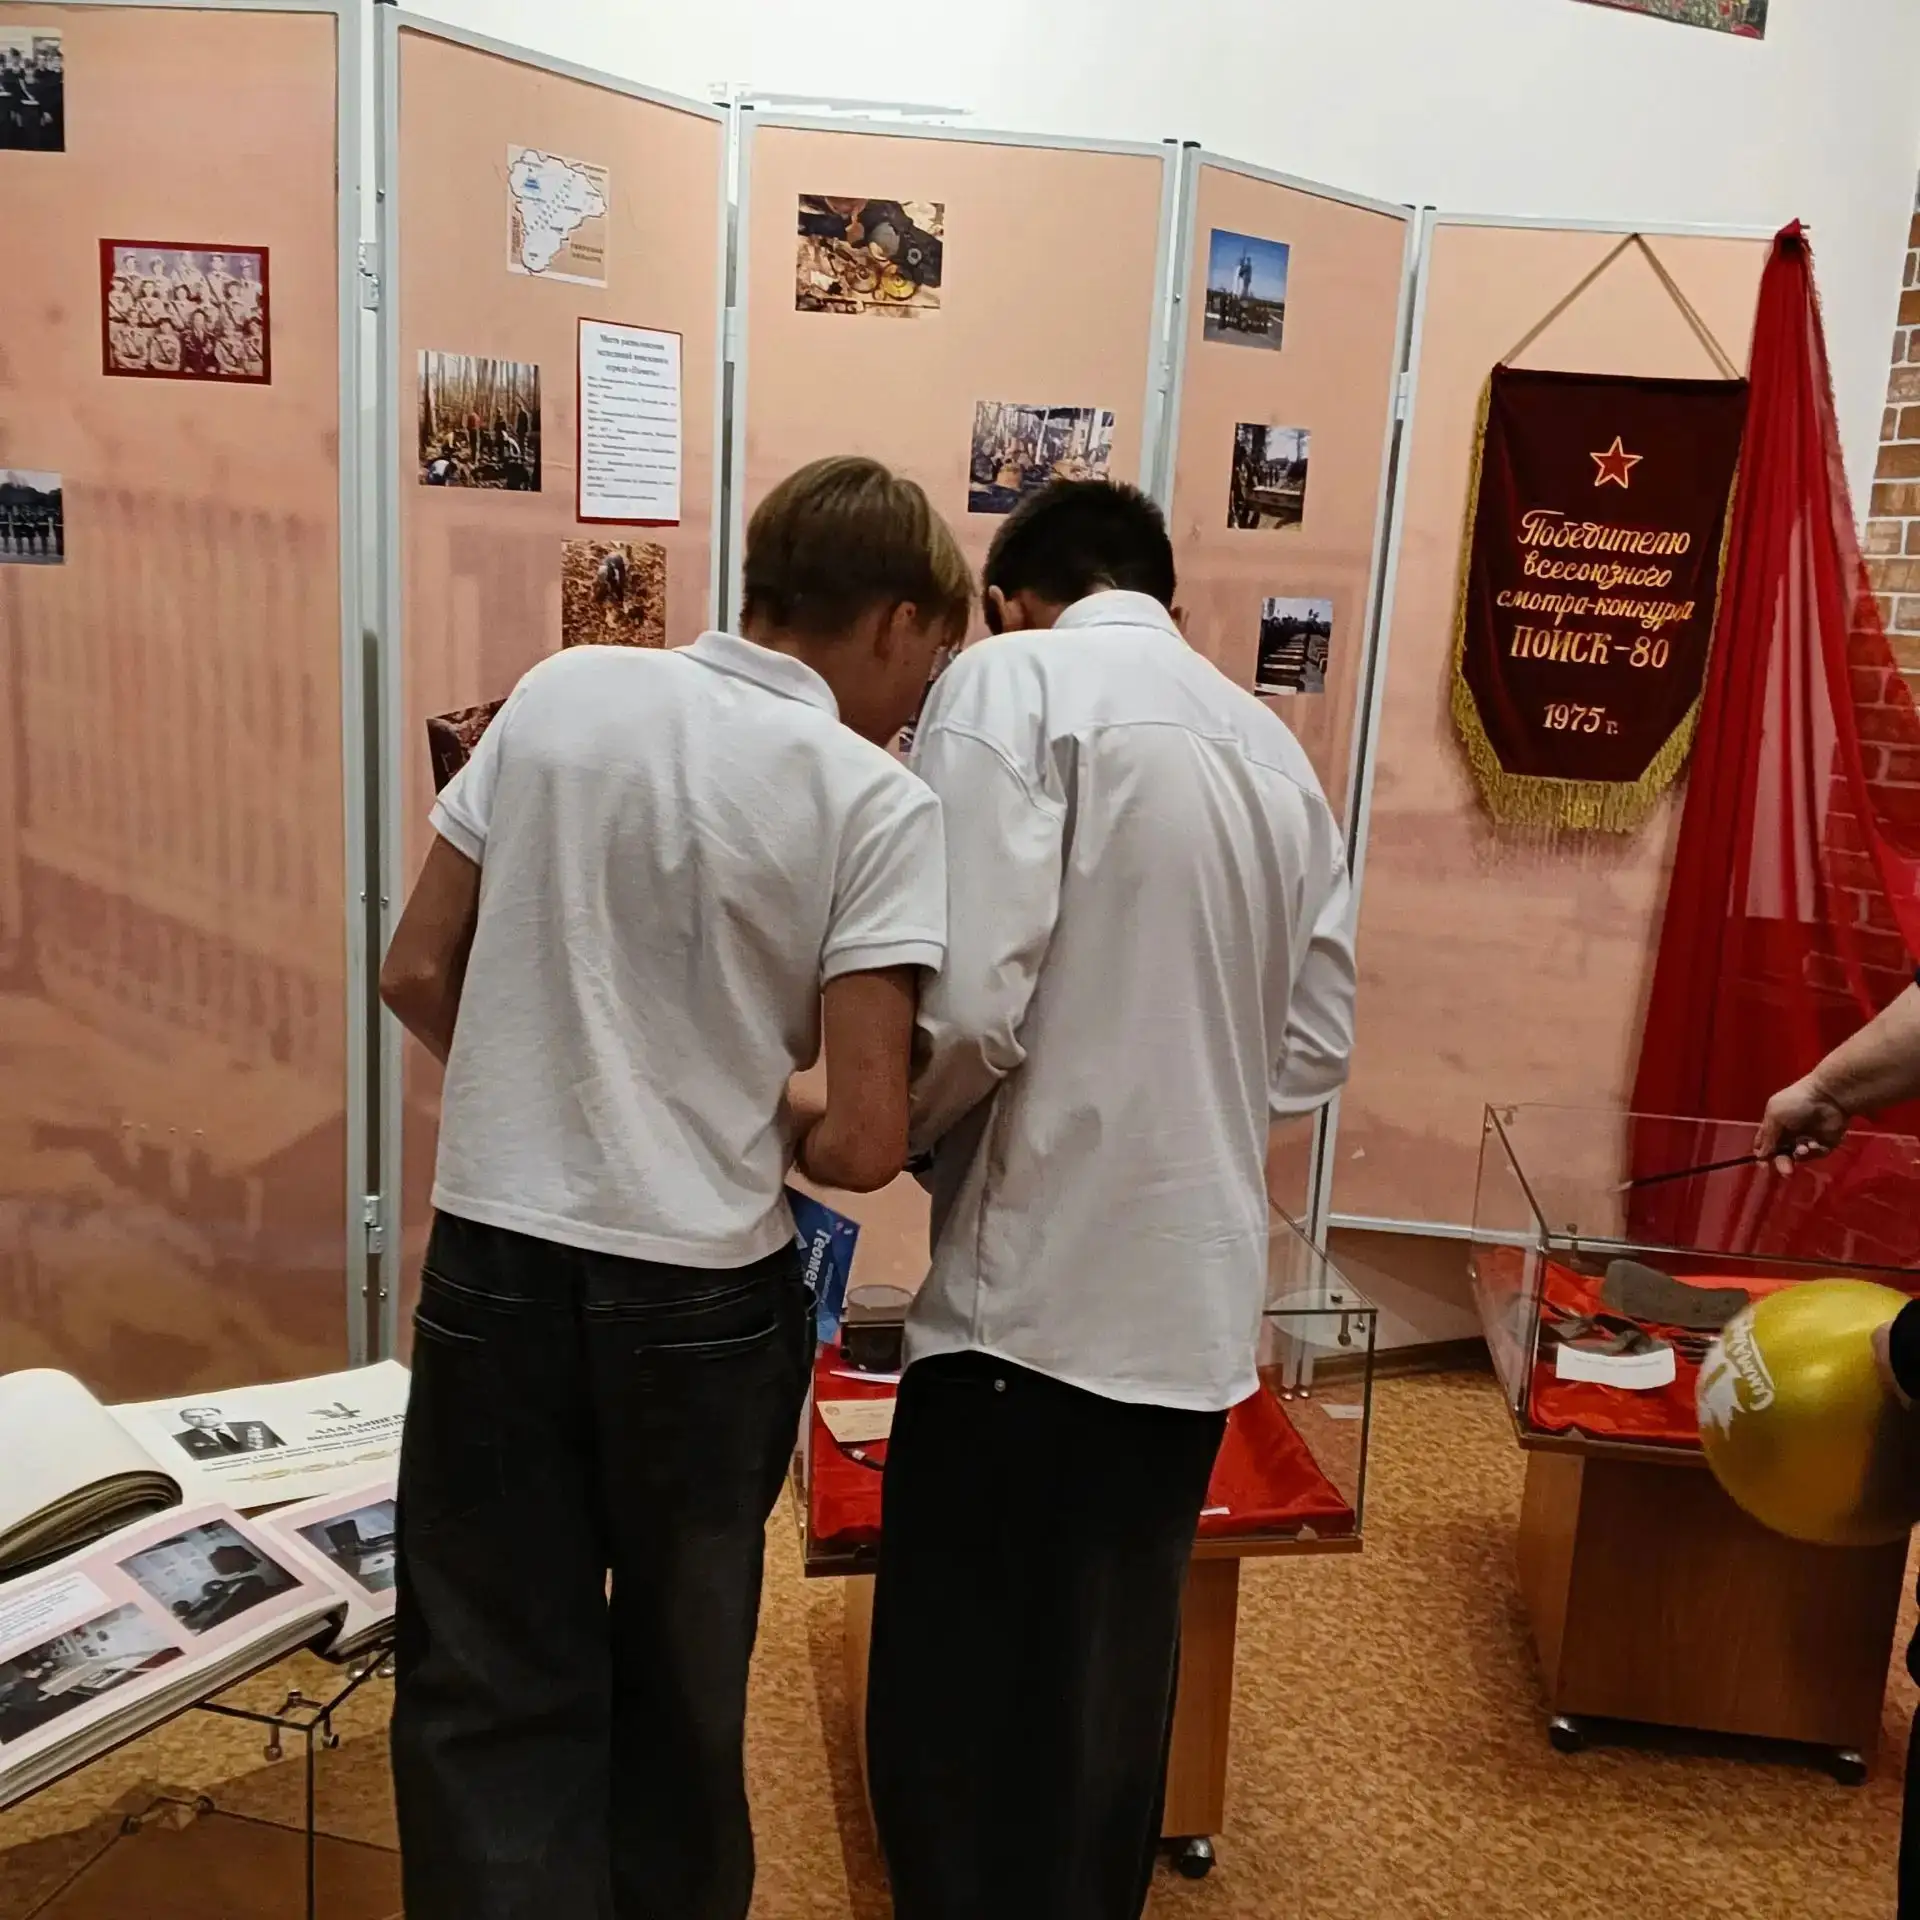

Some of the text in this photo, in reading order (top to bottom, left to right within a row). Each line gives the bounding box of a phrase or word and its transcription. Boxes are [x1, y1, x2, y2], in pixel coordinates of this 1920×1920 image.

[1517, 510, 1691, 555] Победителю
[1523, 550, 1673, 590] всесоюзного
[1542, 703, 1605, 733] 1975
[804, 1228, 832, 1291] Геомет
